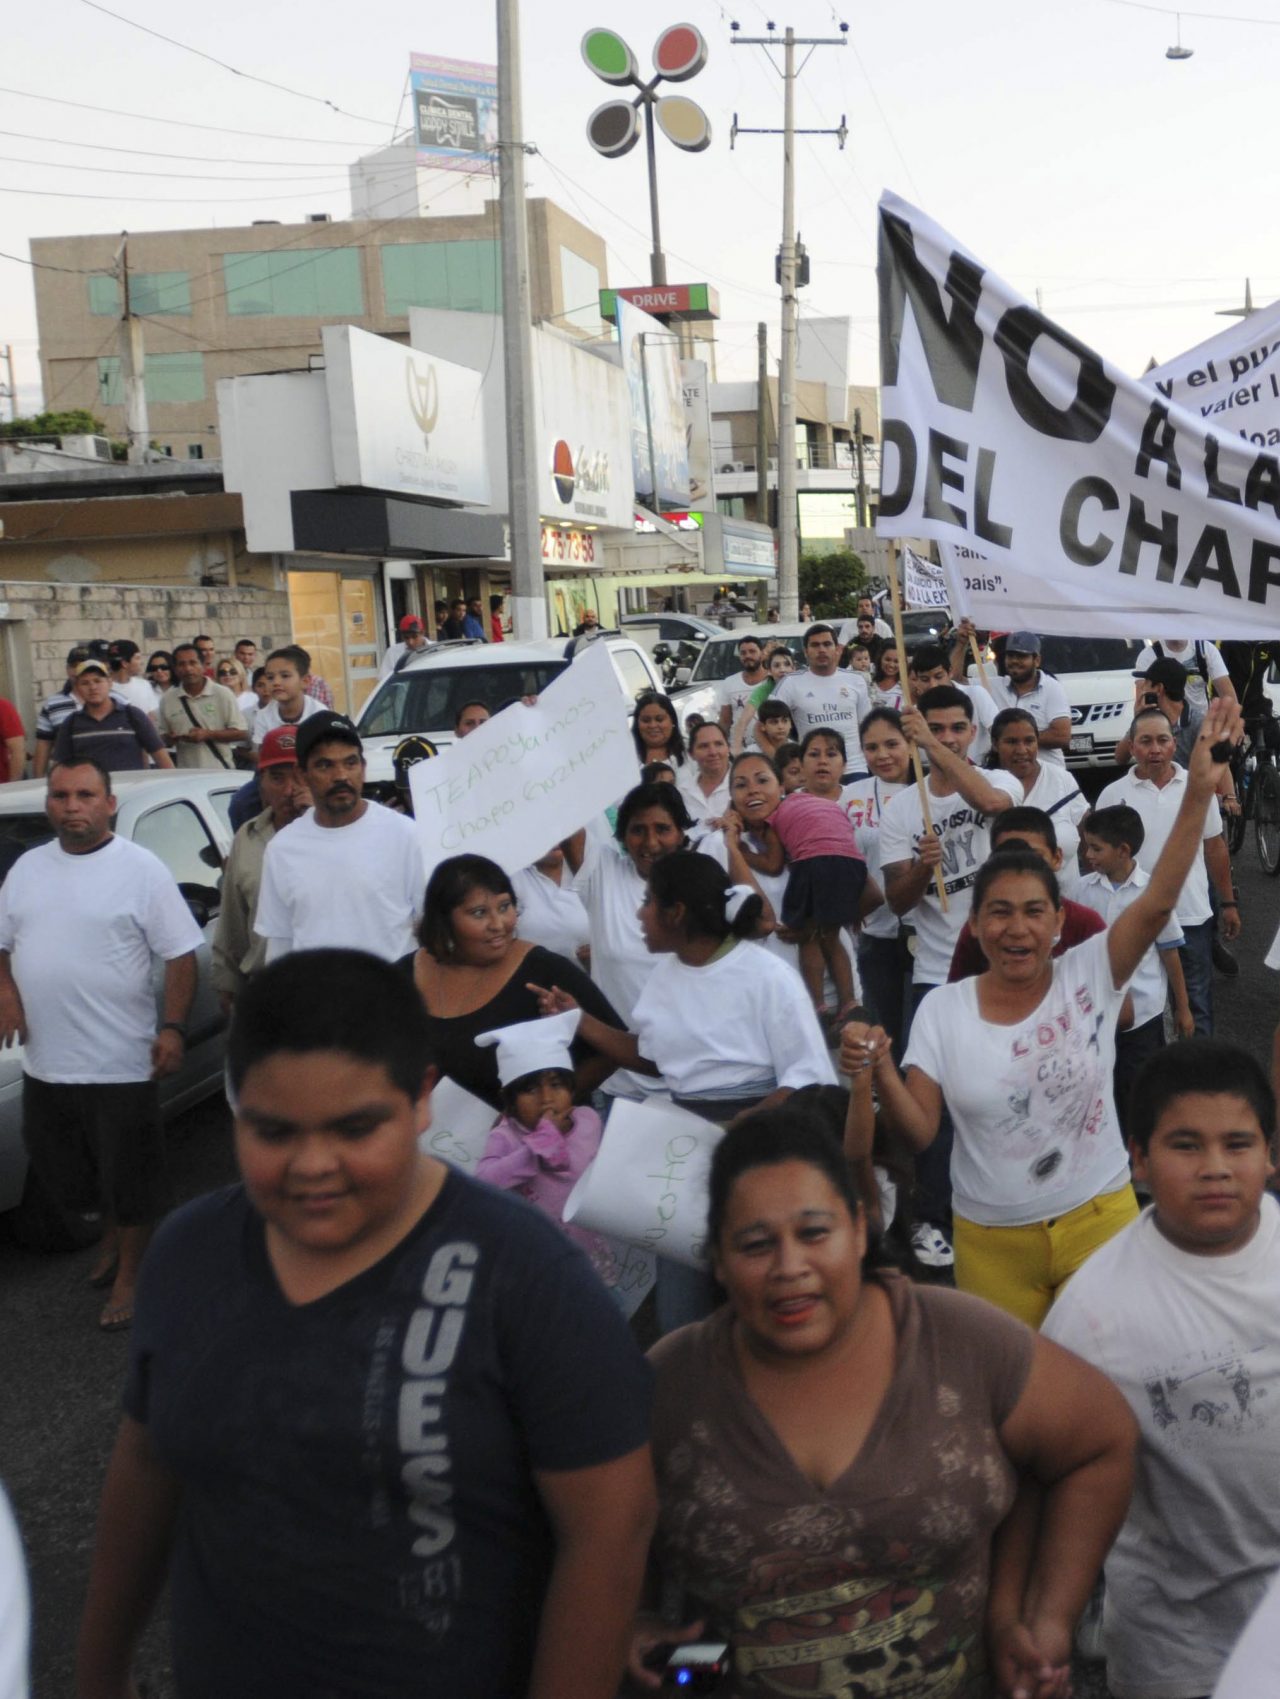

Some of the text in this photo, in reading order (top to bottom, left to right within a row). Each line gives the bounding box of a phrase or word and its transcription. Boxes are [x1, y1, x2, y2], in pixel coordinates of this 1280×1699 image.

[632, 292, 678, 307] DRIVE
[878, 206, 1117, 443] NO
[1134, 398, 1182, 490] A
[1187, 360, 1218, 387] el
[877, 418, 1013, 550] DEL
[807, 711, 854, 724] Emirates
[940, 829, 977, 877] NY
[397, 1241, 480, 1558] GUESS
